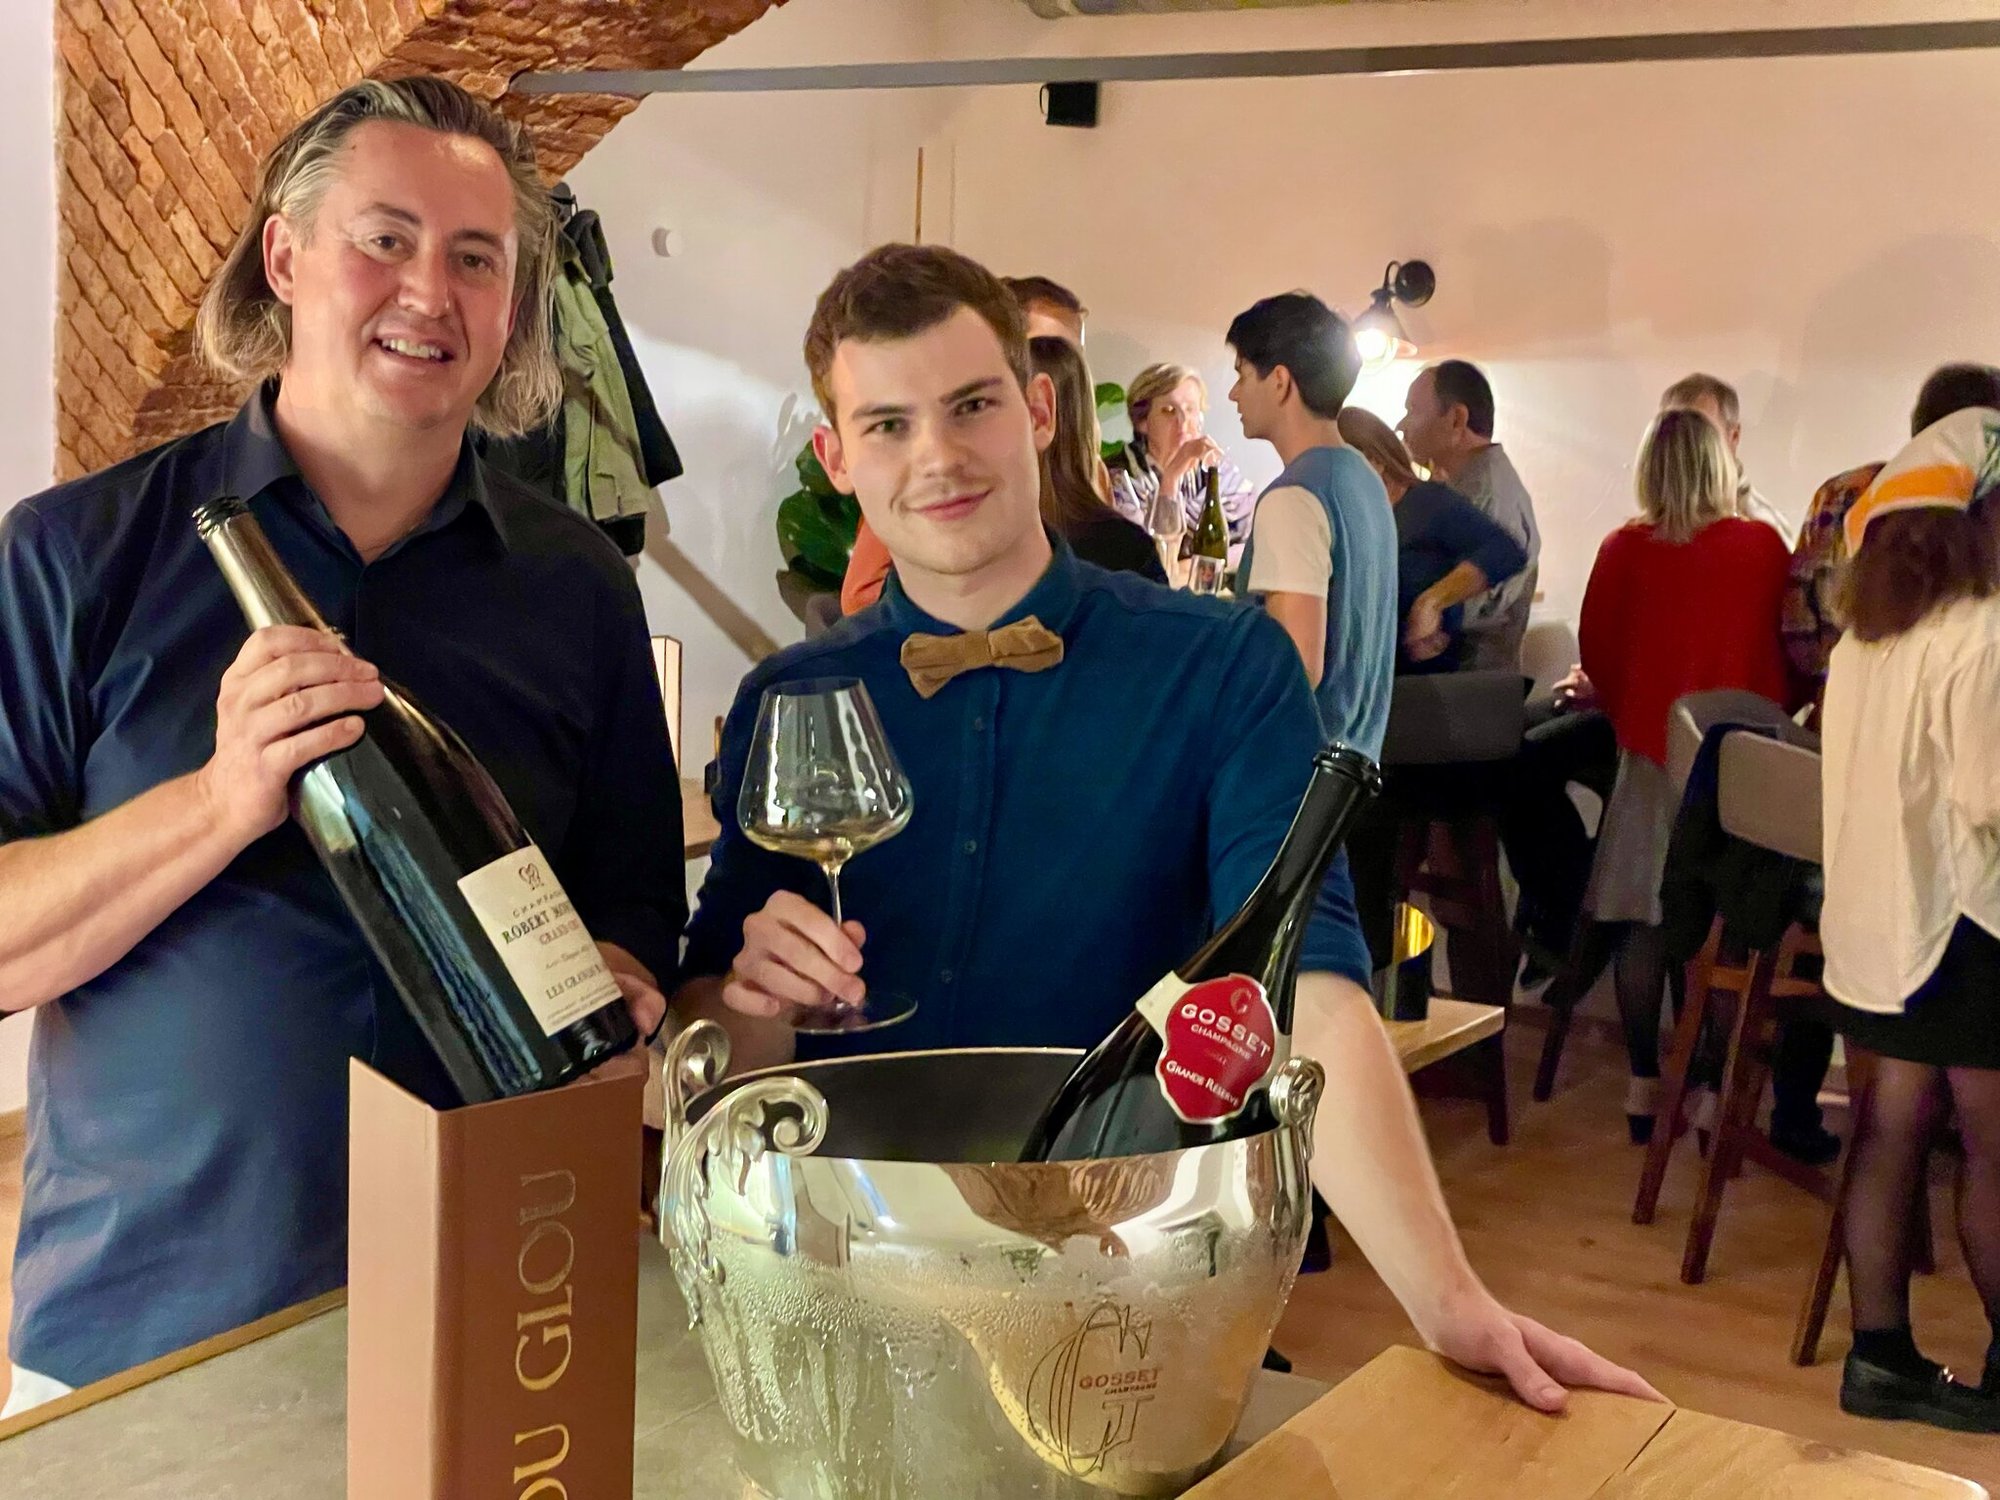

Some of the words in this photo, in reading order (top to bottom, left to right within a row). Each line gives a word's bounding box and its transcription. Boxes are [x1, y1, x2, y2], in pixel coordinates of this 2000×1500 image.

[502, 910, 550, 944] ROBERT
[1181, 1003, 1271, 1058] GOSSET
[1190, 1023, 1252, 1060] CHAMPAGNE
[515, 1169, 576, 1391] GLOU
[1079, 1366, 1163, 1390] GOSSET
